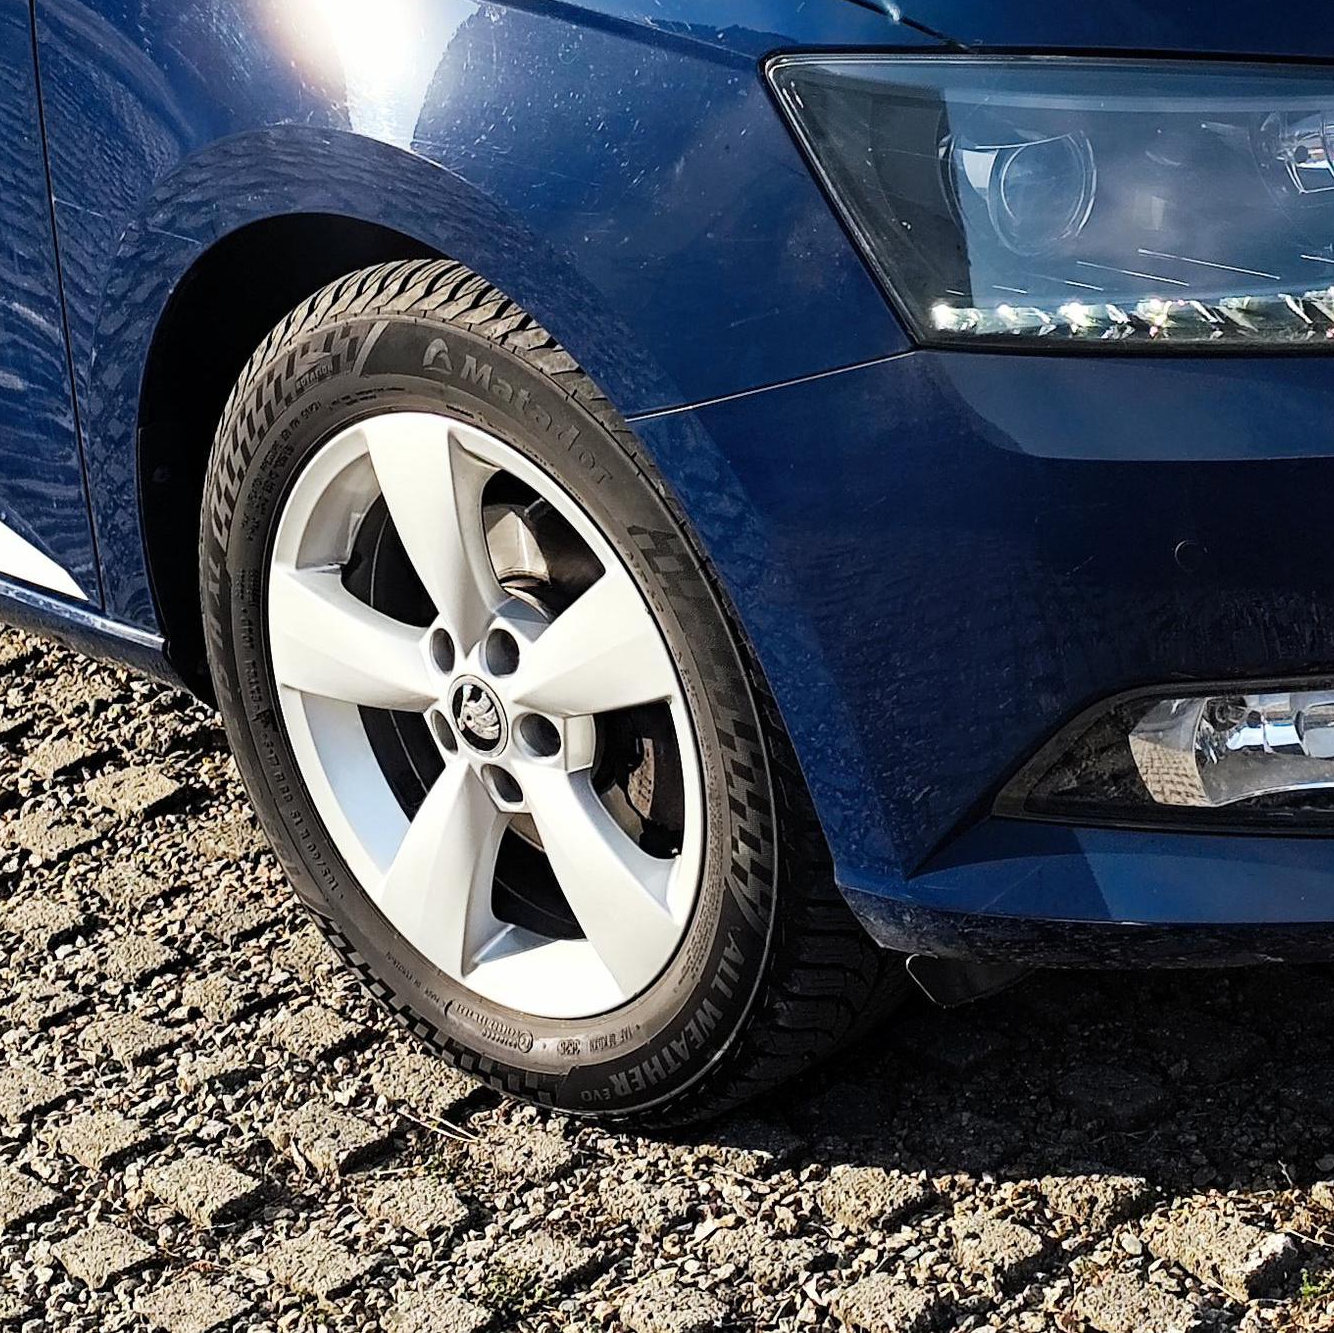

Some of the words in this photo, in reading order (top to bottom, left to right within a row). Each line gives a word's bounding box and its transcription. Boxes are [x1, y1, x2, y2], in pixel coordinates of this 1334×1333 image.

[460, 353, 614, 486] Matador
[710, 931, 746, 1000] ALL
[608, 997, 724, 1097] WEATHER
[581, 1087, 612, 1103] EVO
